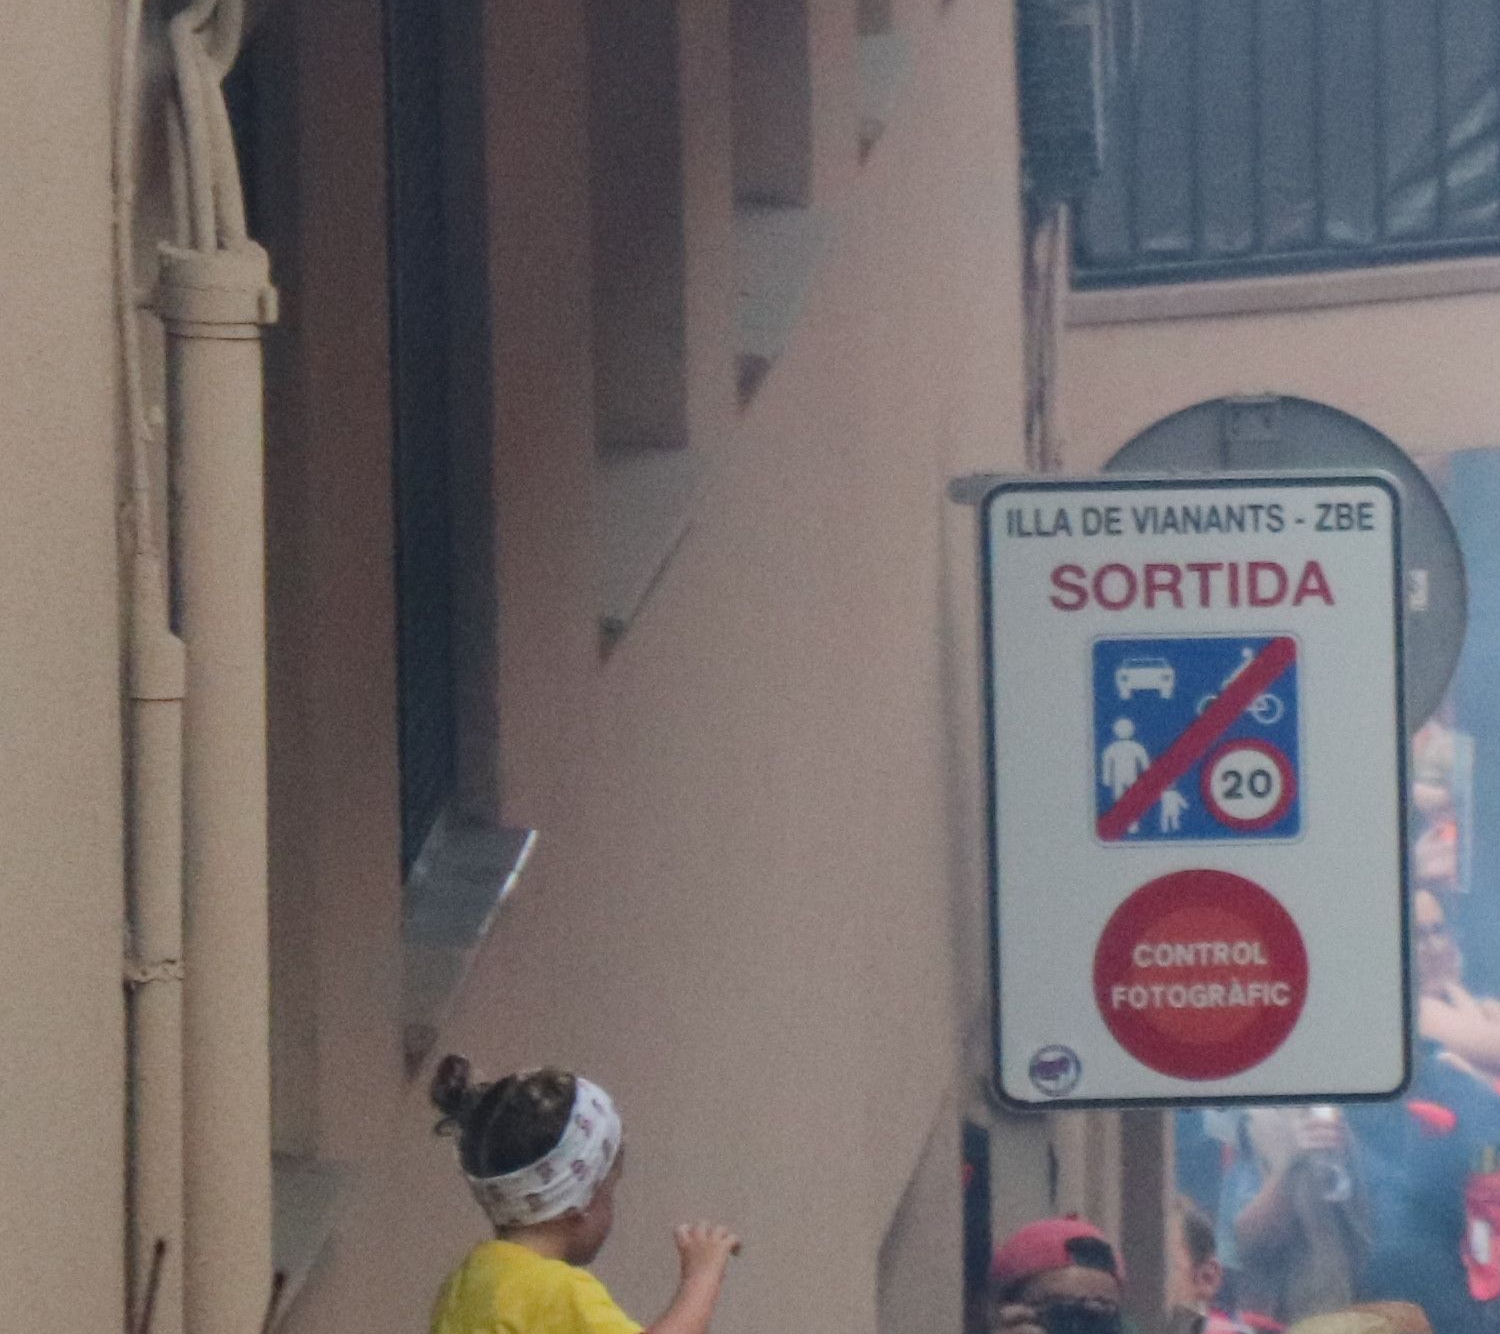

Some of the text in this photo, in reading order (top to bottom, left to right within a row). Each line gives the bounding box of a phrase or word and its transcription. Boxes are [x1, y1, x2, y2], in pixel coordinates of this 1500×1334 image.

[1007, 508, 1072, 537] ILLA
[1082, 507, 1123, 536] DE
[1131, 504, 1286, 535] VIANANTS
[1315, 502, 1375, 532] ZBE
[1050, 561, 1335, 611] SORTIDA
[1222, 770, 1272, 799] 20
[1133, 941, 1268, 967] CONTROL
[1112, 976, 1291, 1010] FOTOGRÀFIC
